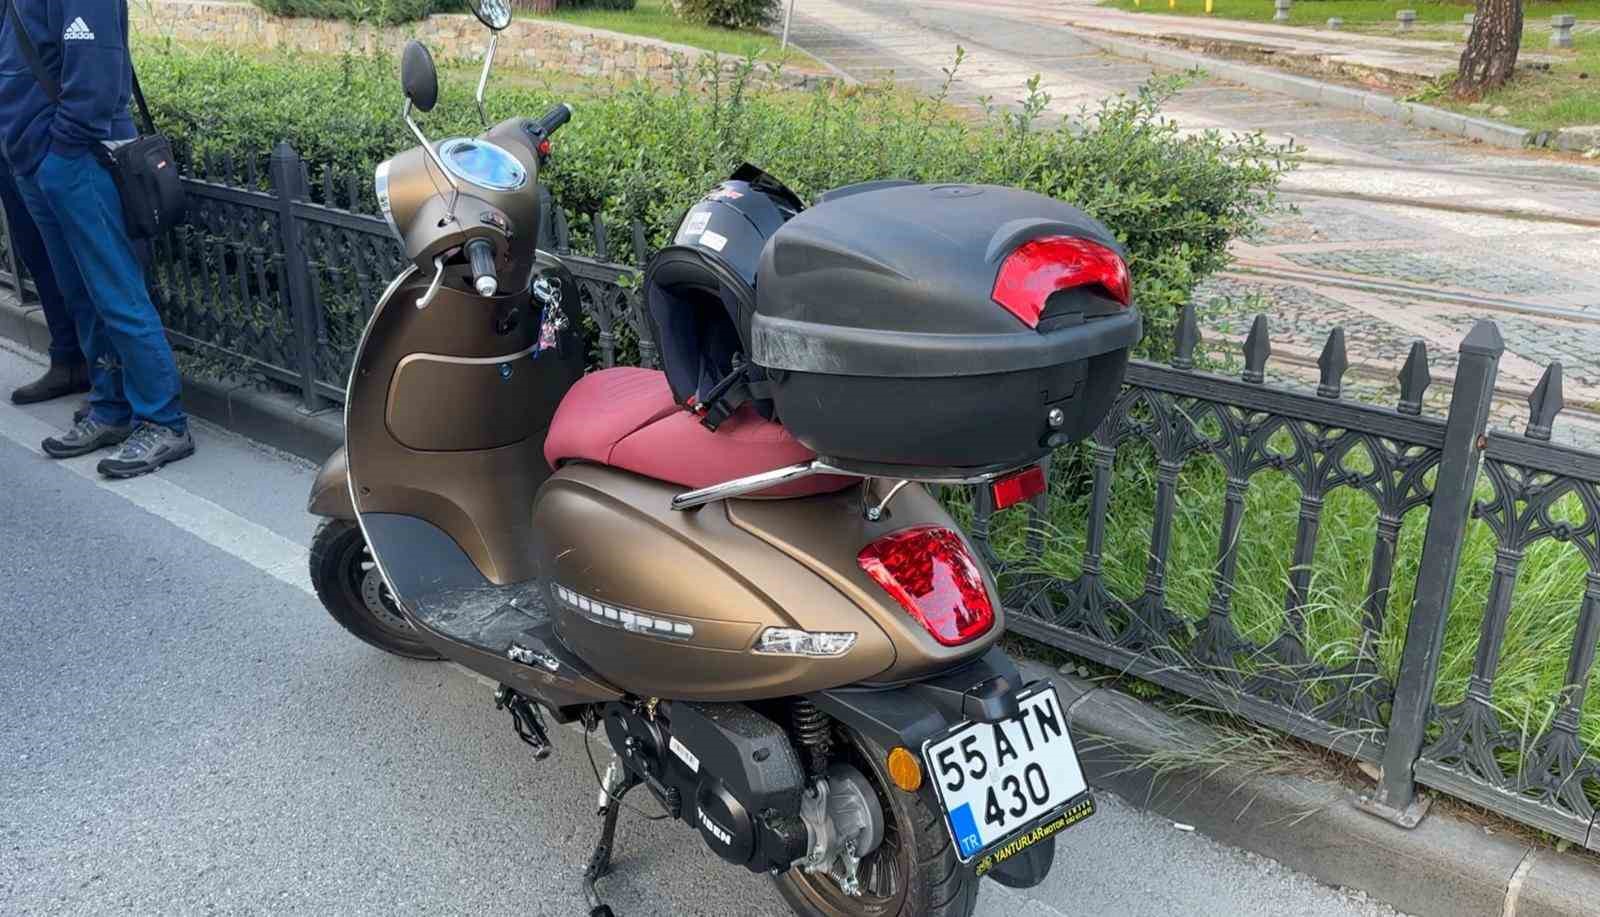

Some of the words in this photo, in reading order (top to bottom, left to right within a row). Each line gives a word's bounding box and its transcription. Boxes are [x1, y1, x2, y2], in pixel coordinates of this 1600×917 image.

[64, 31, 95, 41] adidas
[936, 735, 987, 792] 55
[992, 698, 1062, 767] ATN
[984, 762, 1050, 827] 430
[961, 835, 979, 852] TR
[994, 827, 1044, 862] YANTURLAR
